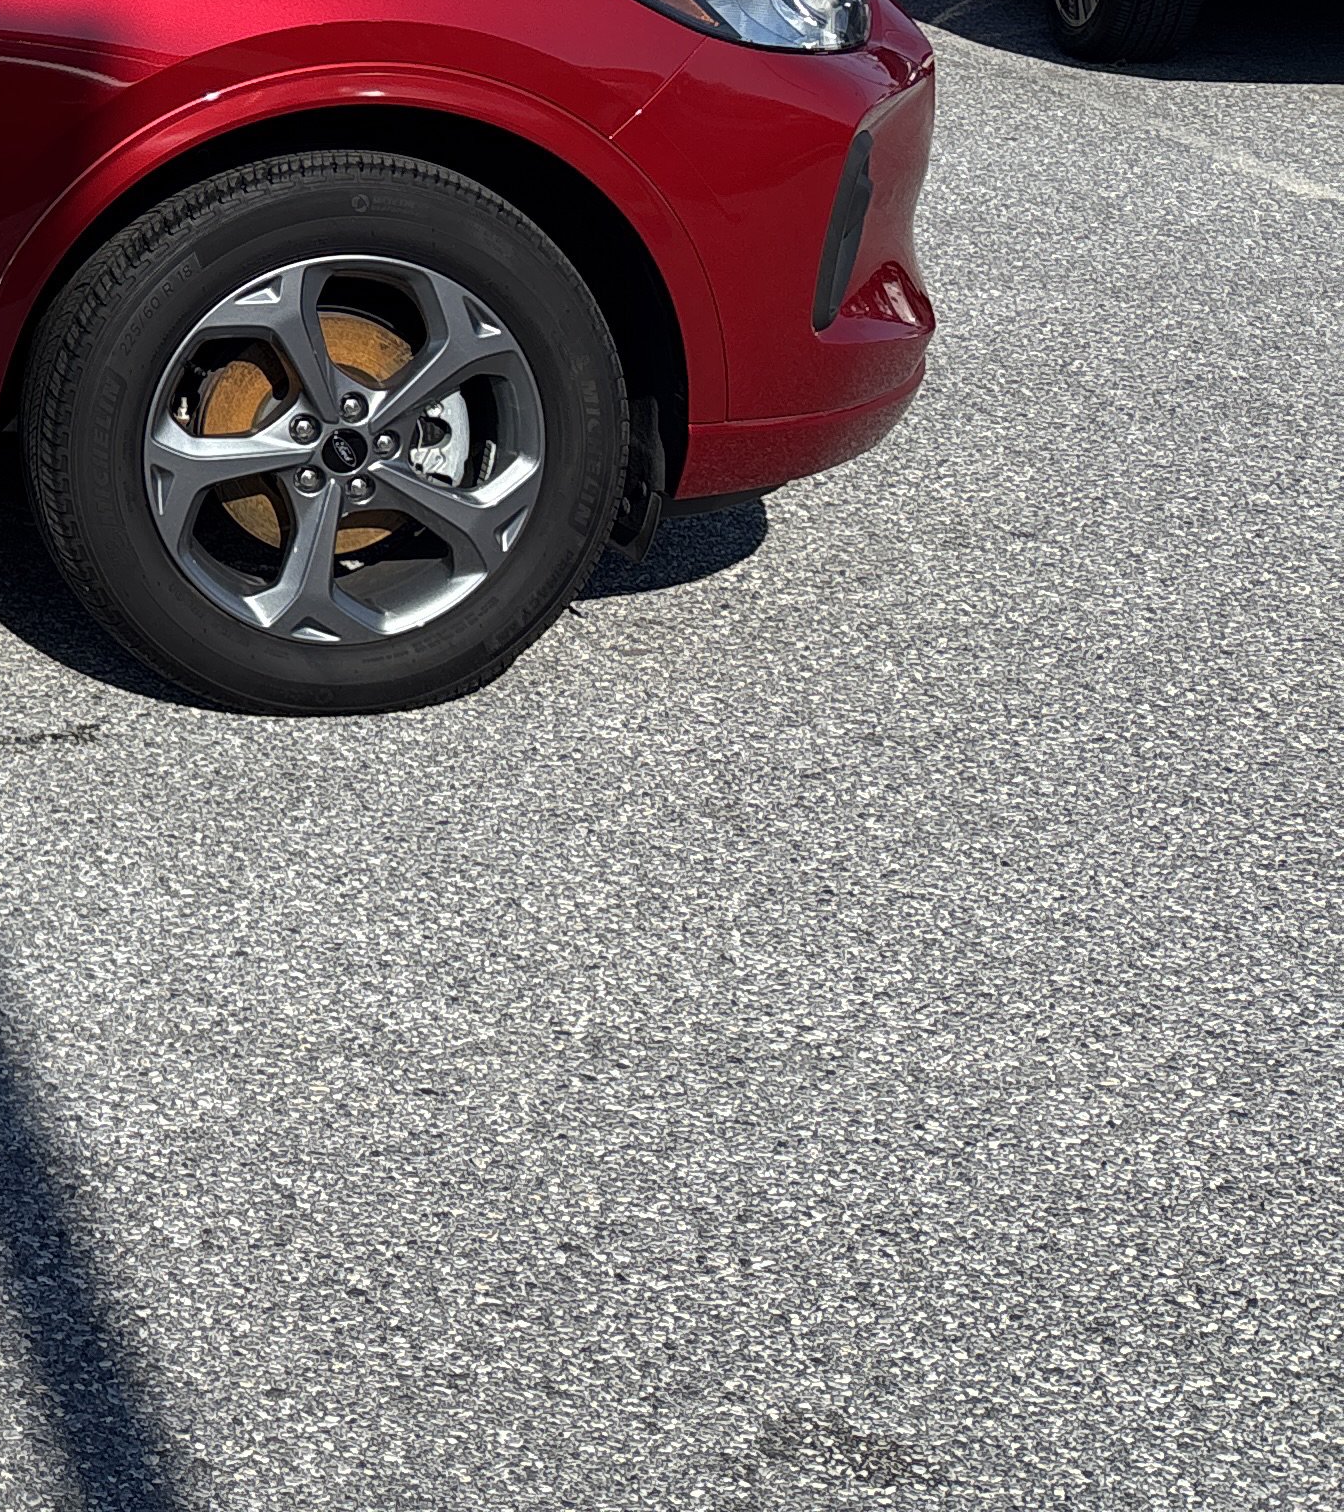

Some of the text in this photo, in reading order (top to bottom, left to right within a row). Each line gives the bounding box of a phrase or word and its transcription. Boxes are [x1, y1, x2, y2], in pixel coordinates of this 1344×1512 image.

[120, 264, 192, 357] 225/60 R 18
[90, 377, 122, 520] MICHELIN
